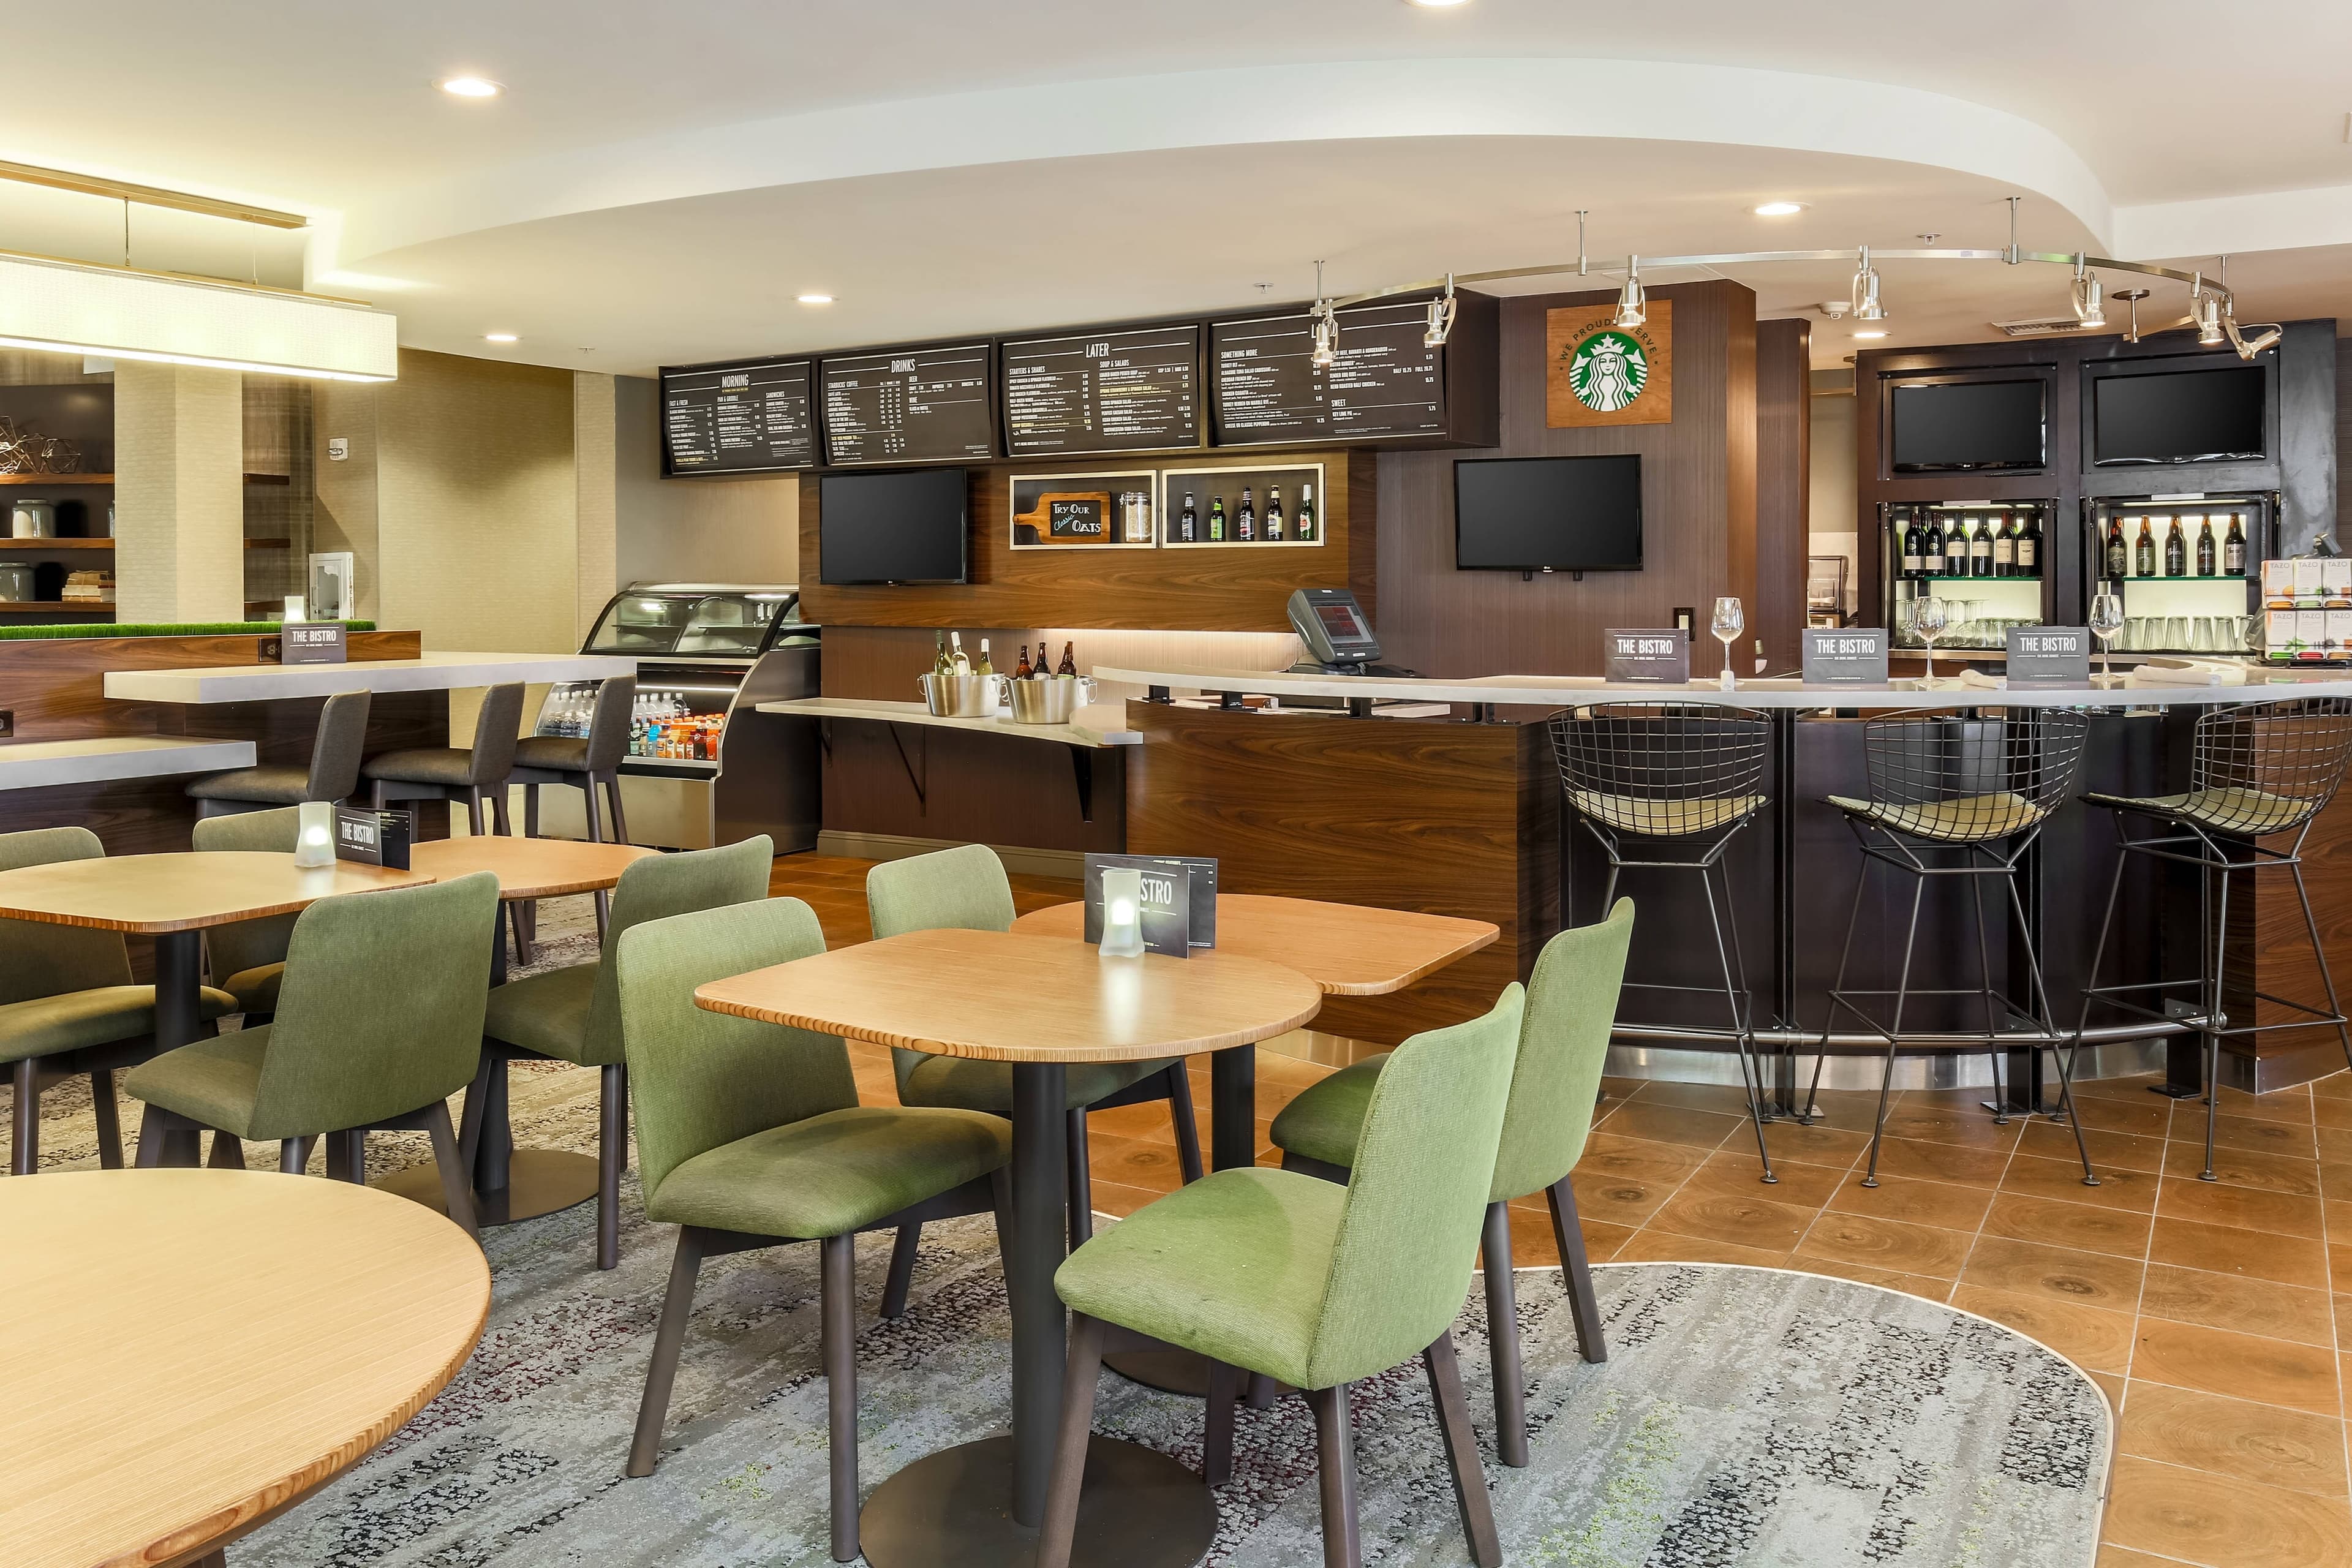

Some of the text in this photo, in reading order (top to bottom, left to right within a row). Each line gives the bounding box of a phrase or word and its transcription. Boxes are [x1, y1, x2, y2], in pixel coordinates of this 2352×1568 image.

[1560, 318, 1657, 360] WE PROUD ERVE
[1086, 343, 1109, 358] LATER
[1221, 350, 1245, 360] SOMETHING
[892, 359, 915, 372] DRINKS
[722, 375, 748, 388] MORNING
[1054, 514, 1075, 531] Classic
[292, 631, 336, 642] THE BISTRO
[1617, 639, 1672, 654] THE BISTRO
[1817, 639, 1875, 653] THE BISTRO
[2020, 638, 2076, 651] THE BISTRO
[342, 822, 374, 844] THE BISTRO
[1140, 878, 1172, 905] STRO
